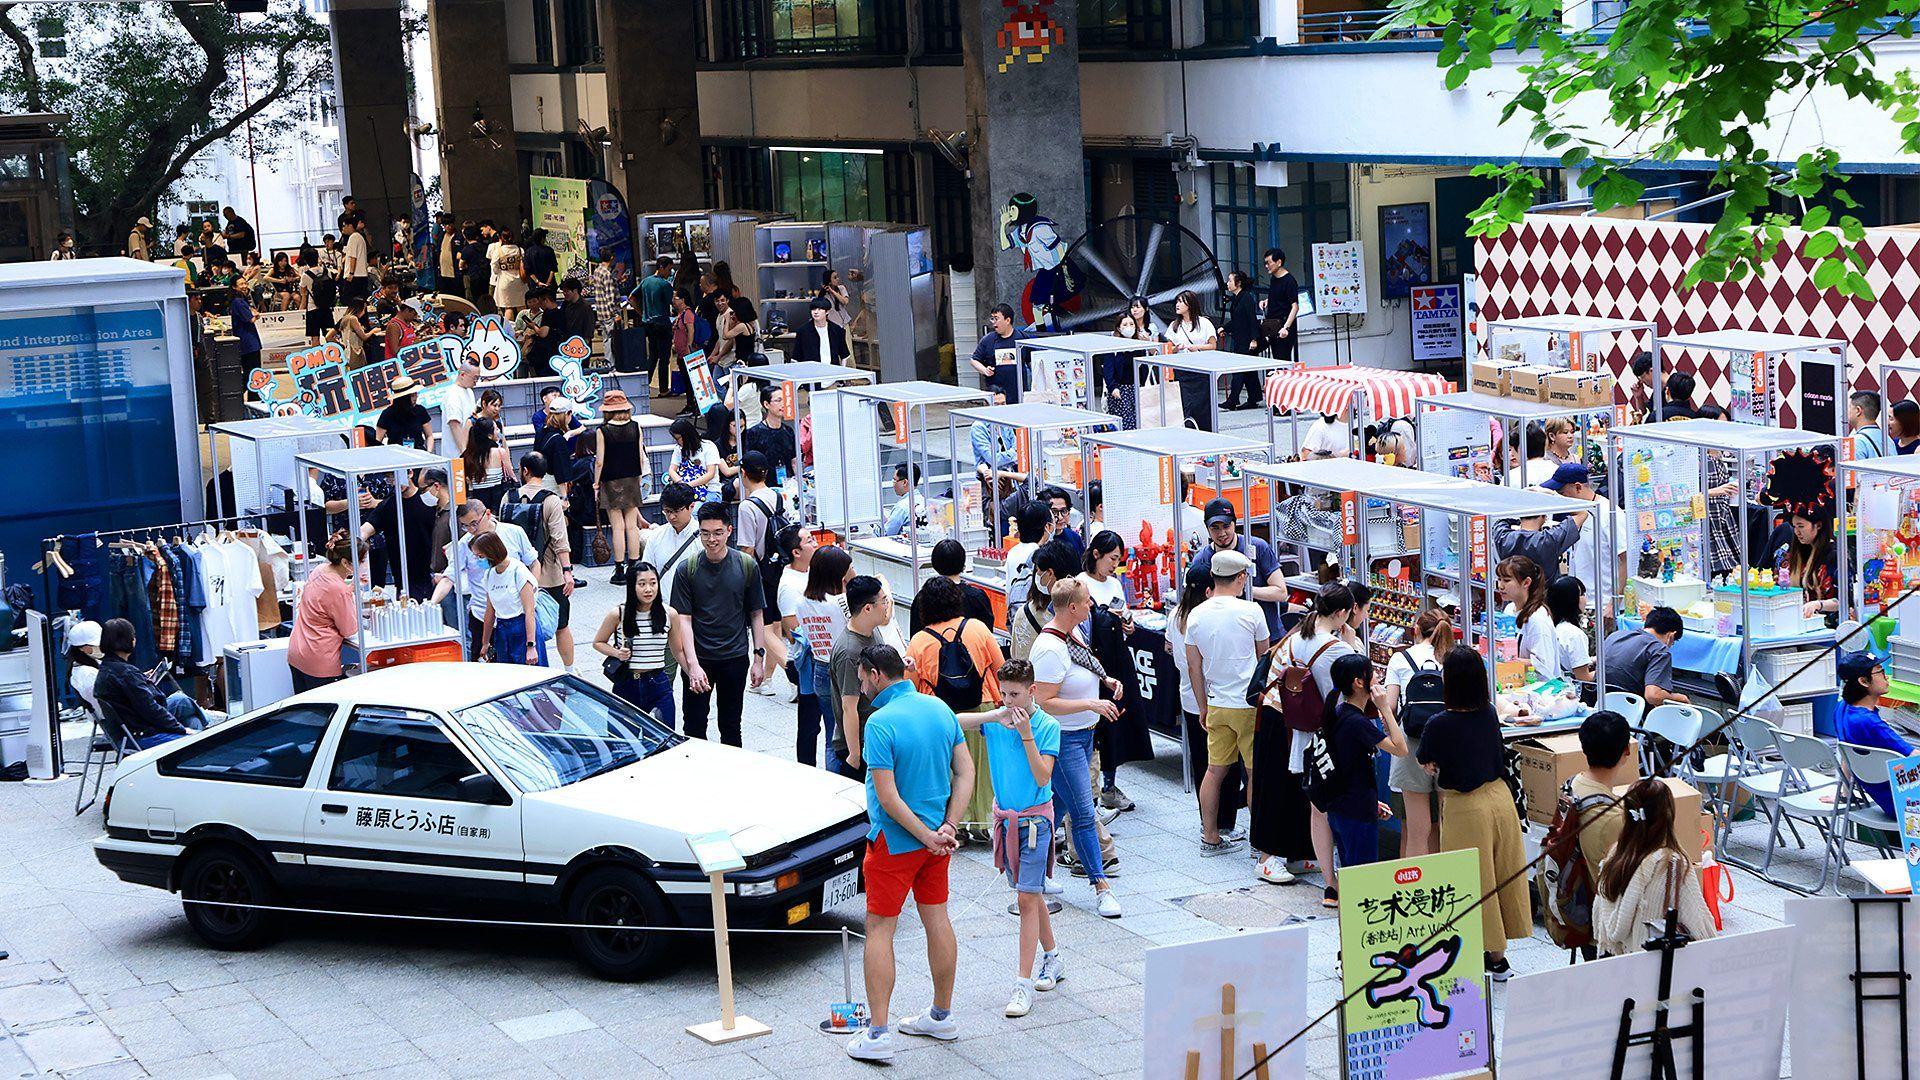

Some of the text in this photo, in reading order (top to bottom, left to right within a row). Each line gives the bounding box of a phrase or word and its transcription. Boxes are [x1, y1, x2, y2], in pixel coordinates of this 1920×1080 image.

[1413, 310, 1459, 319] TAMIYA
[0, 336, 20, 347] nd
[122, 329, 153, 338] Area
[291, 345, 343, 375] PMQ
[1345, 500, 1355, 535] DDED
[356, 806, 491, 839] 藤原とうふ店 (自家用)
[842, 872, 851, 884] 52
[1361, 926, 1402, 949] (香港站)
[1406, 925, 1426, 938] Art
